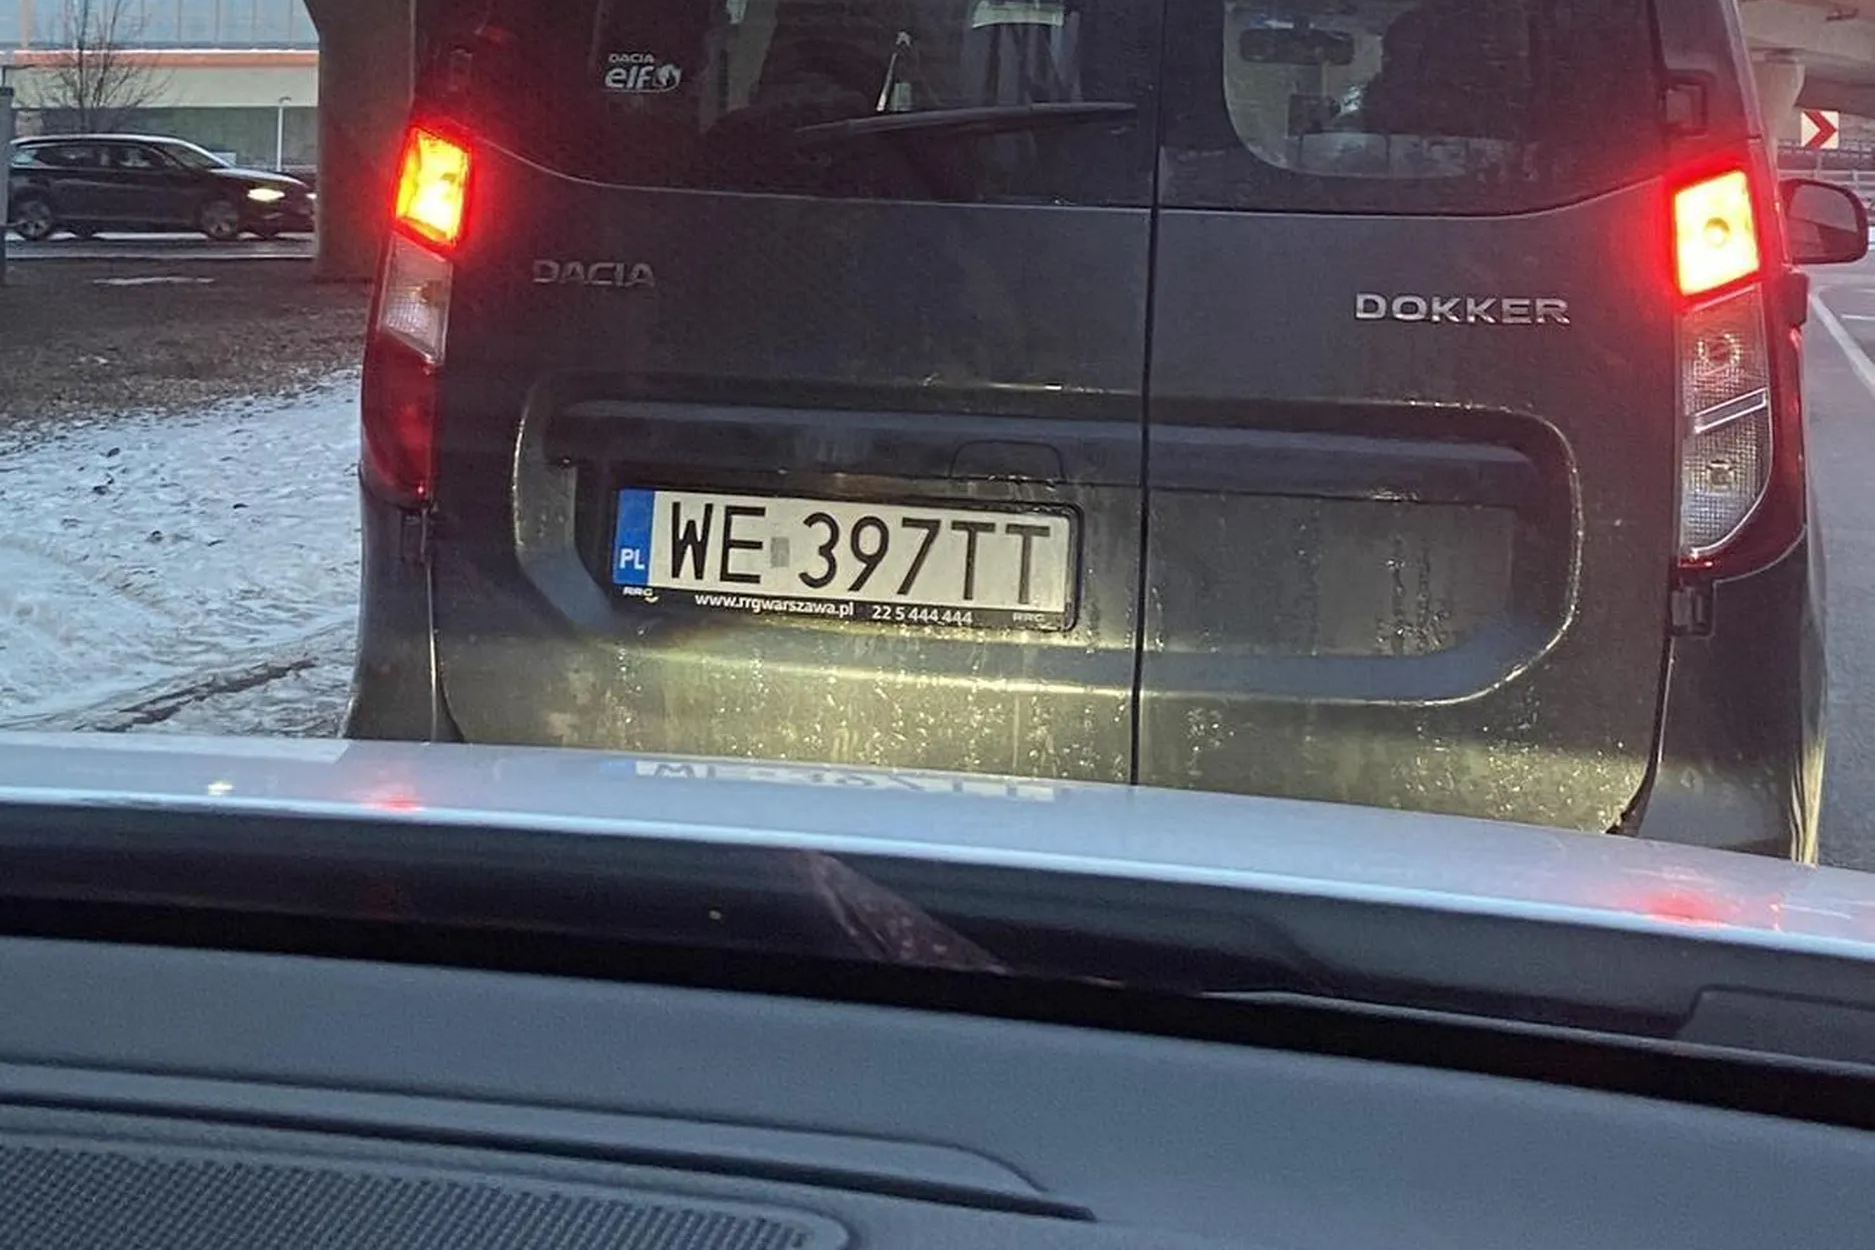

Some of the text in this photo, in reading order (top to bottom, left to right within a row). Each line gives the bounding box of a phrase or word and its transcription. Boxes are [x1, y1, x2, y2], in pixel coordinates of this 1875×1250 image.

[607, 53, 655, 64] DACIA
[604, 65, 655, 89] elf
[532, 258, 656, 288] DACIA
[1354, 292, 1572, 325] DOKKER
[619, 547, 646, 571] PL
[670, 500, 1052, 606] WE 397TT
[694, 593, 854, 618] www.rrgwarszawa.pl
[871, 604, 974, 626] 22 5 444 444
